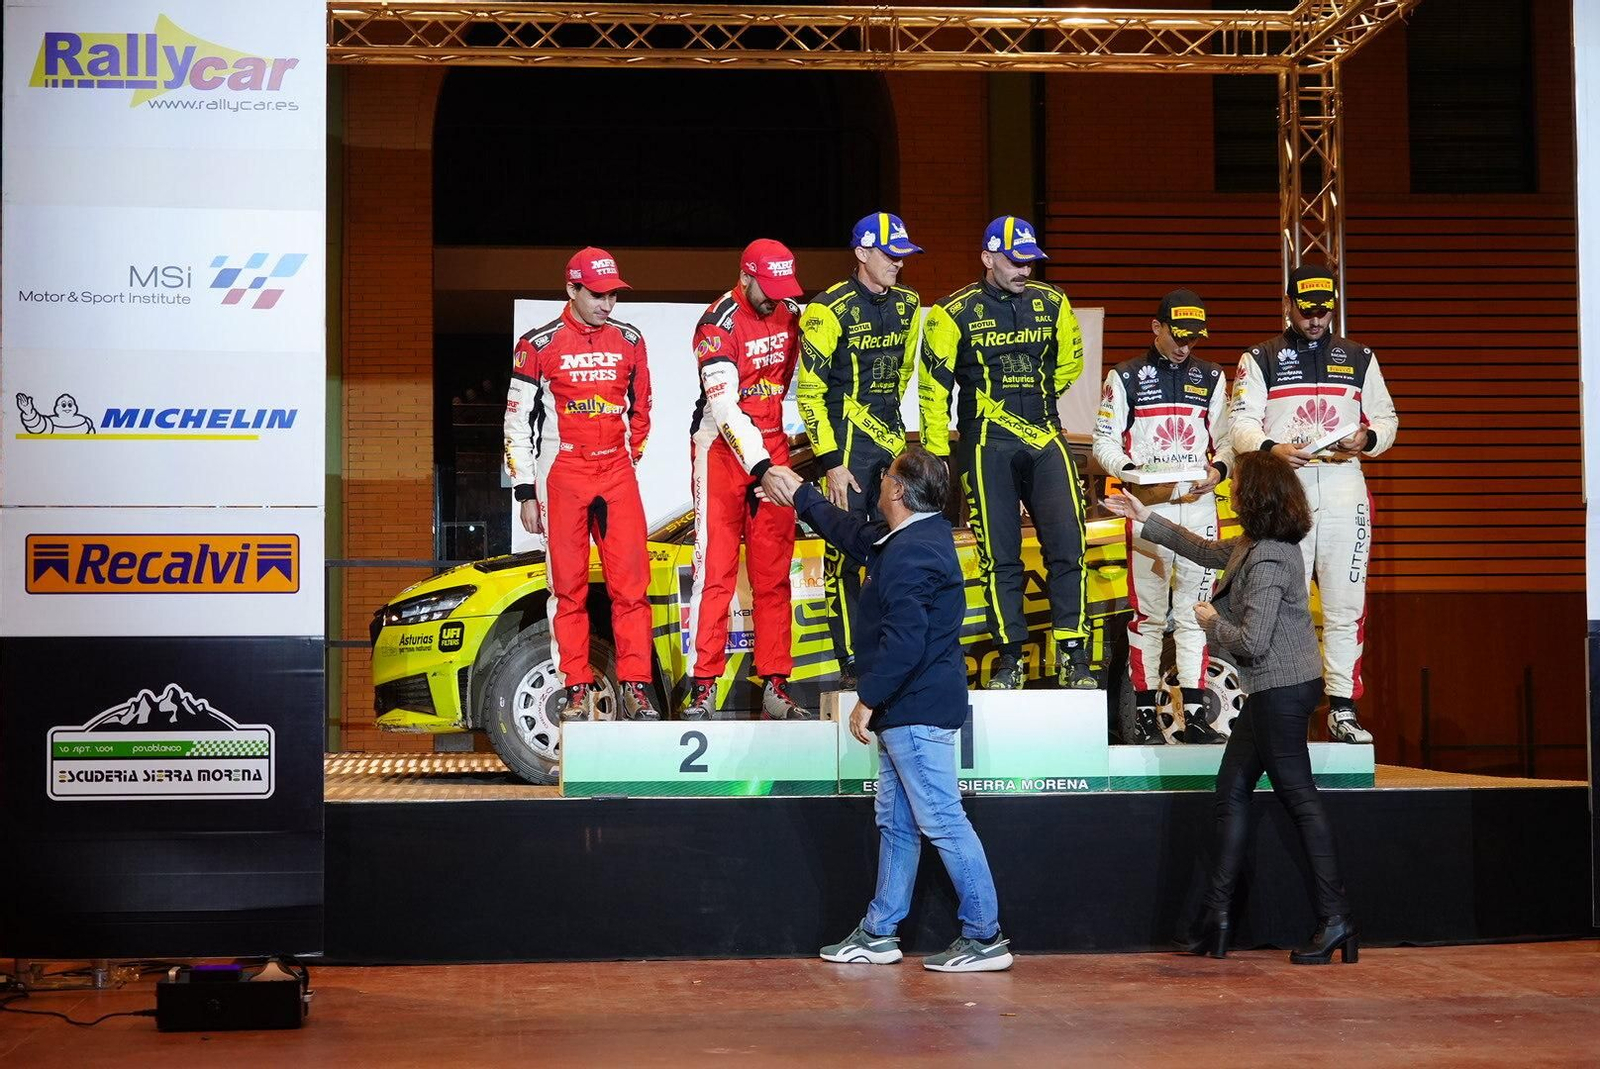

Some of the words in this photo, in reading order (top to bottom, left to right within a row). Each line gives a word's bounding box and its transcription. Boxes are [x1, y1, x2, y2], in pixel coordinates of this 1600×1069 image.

[44, 32, 300, 91] Rallycar
[148, 98, 299, 112] www.rallycar.es
[19, 290, 65, 303] Motor
[67, 291, 79, 303] &
[80, 291, 125, 305] Sport
[128, 292, 191, 305] Institute
[970, 320, 995, 331] MOTUL
[984, 327, 1042, 347] Recalvi
[744, 332, 789, 358] MRF
[559, 352, 623, 370] MRF
[569, 369, 617, 383] TYRES
[100, 408, 298, 429] MICHELIN
[75, 543, 250, 584] Recalvi
[398, 633, 434, 647] Asturias
[442, 627, 461, 640] UFI
[679, 730, 709, 773] 2
[197, 768, 263, 783] MORENA
[958, 779, 1015, 791] SIERRA
[1021, 779, 1089, 790] MORENA
